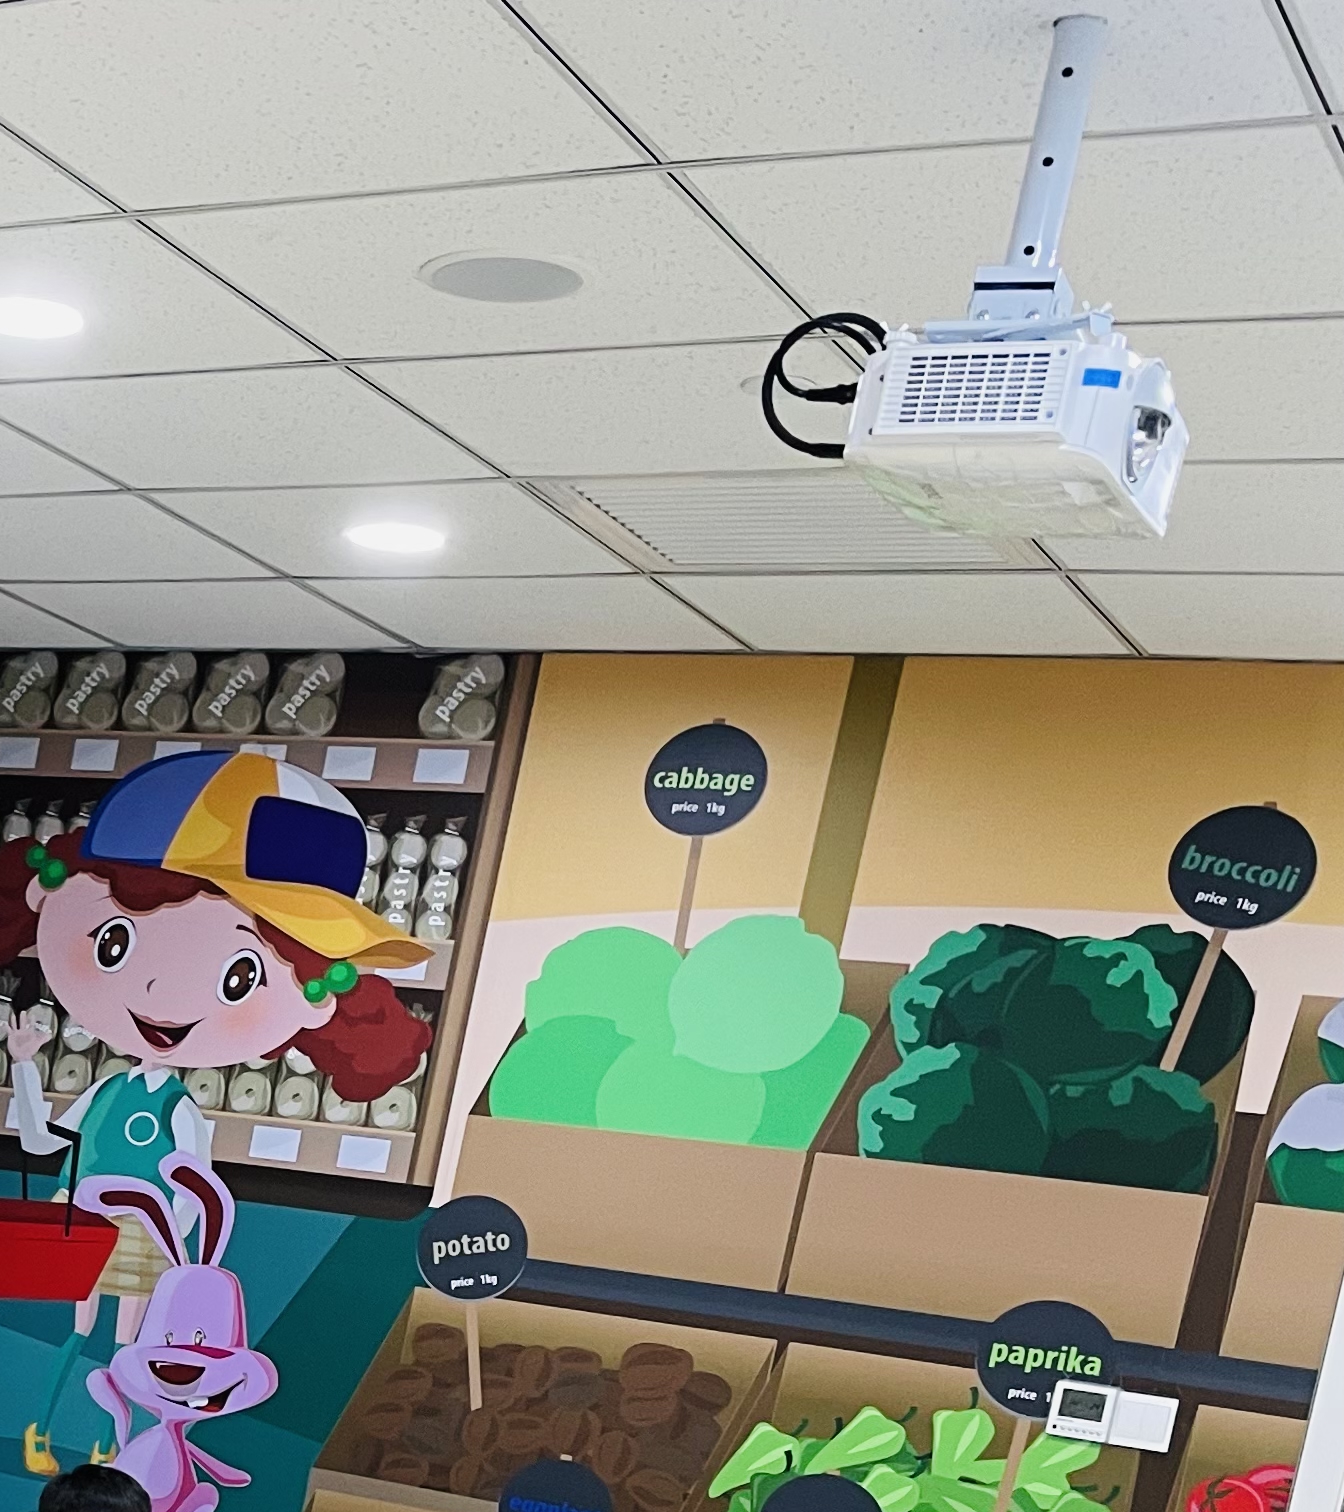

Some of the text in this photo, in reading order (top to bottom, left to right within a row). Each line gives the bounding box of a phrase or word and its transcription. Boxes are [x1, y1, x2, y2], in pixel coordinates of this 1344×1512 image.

[2, 661, 45, 713] pastry
[66, 661, 110, 714] pastry
[134, 662, 181, 717] pastry
[208, 663, 256, 717] pastry
[281, 664, 331, 719] pastry
[435, 666, 486, 722] pastry
[653, 766, 755, 796] cabbage
[671, 801, 726, 816] price 1kg
[388, 853, 417, 923] pastry
[428, 856, 458, 926] pastry
[1181, 844, 1301, 893] broccoli
[1194, 890, 1259, 915] price 1kg
[432, 1231, 510, 1265] potato
[450, 1274, 498, 1290] price 1kg
[988, 1342, 1102, 1377] paprika
[1007, 1386, 1038, 1401] price
